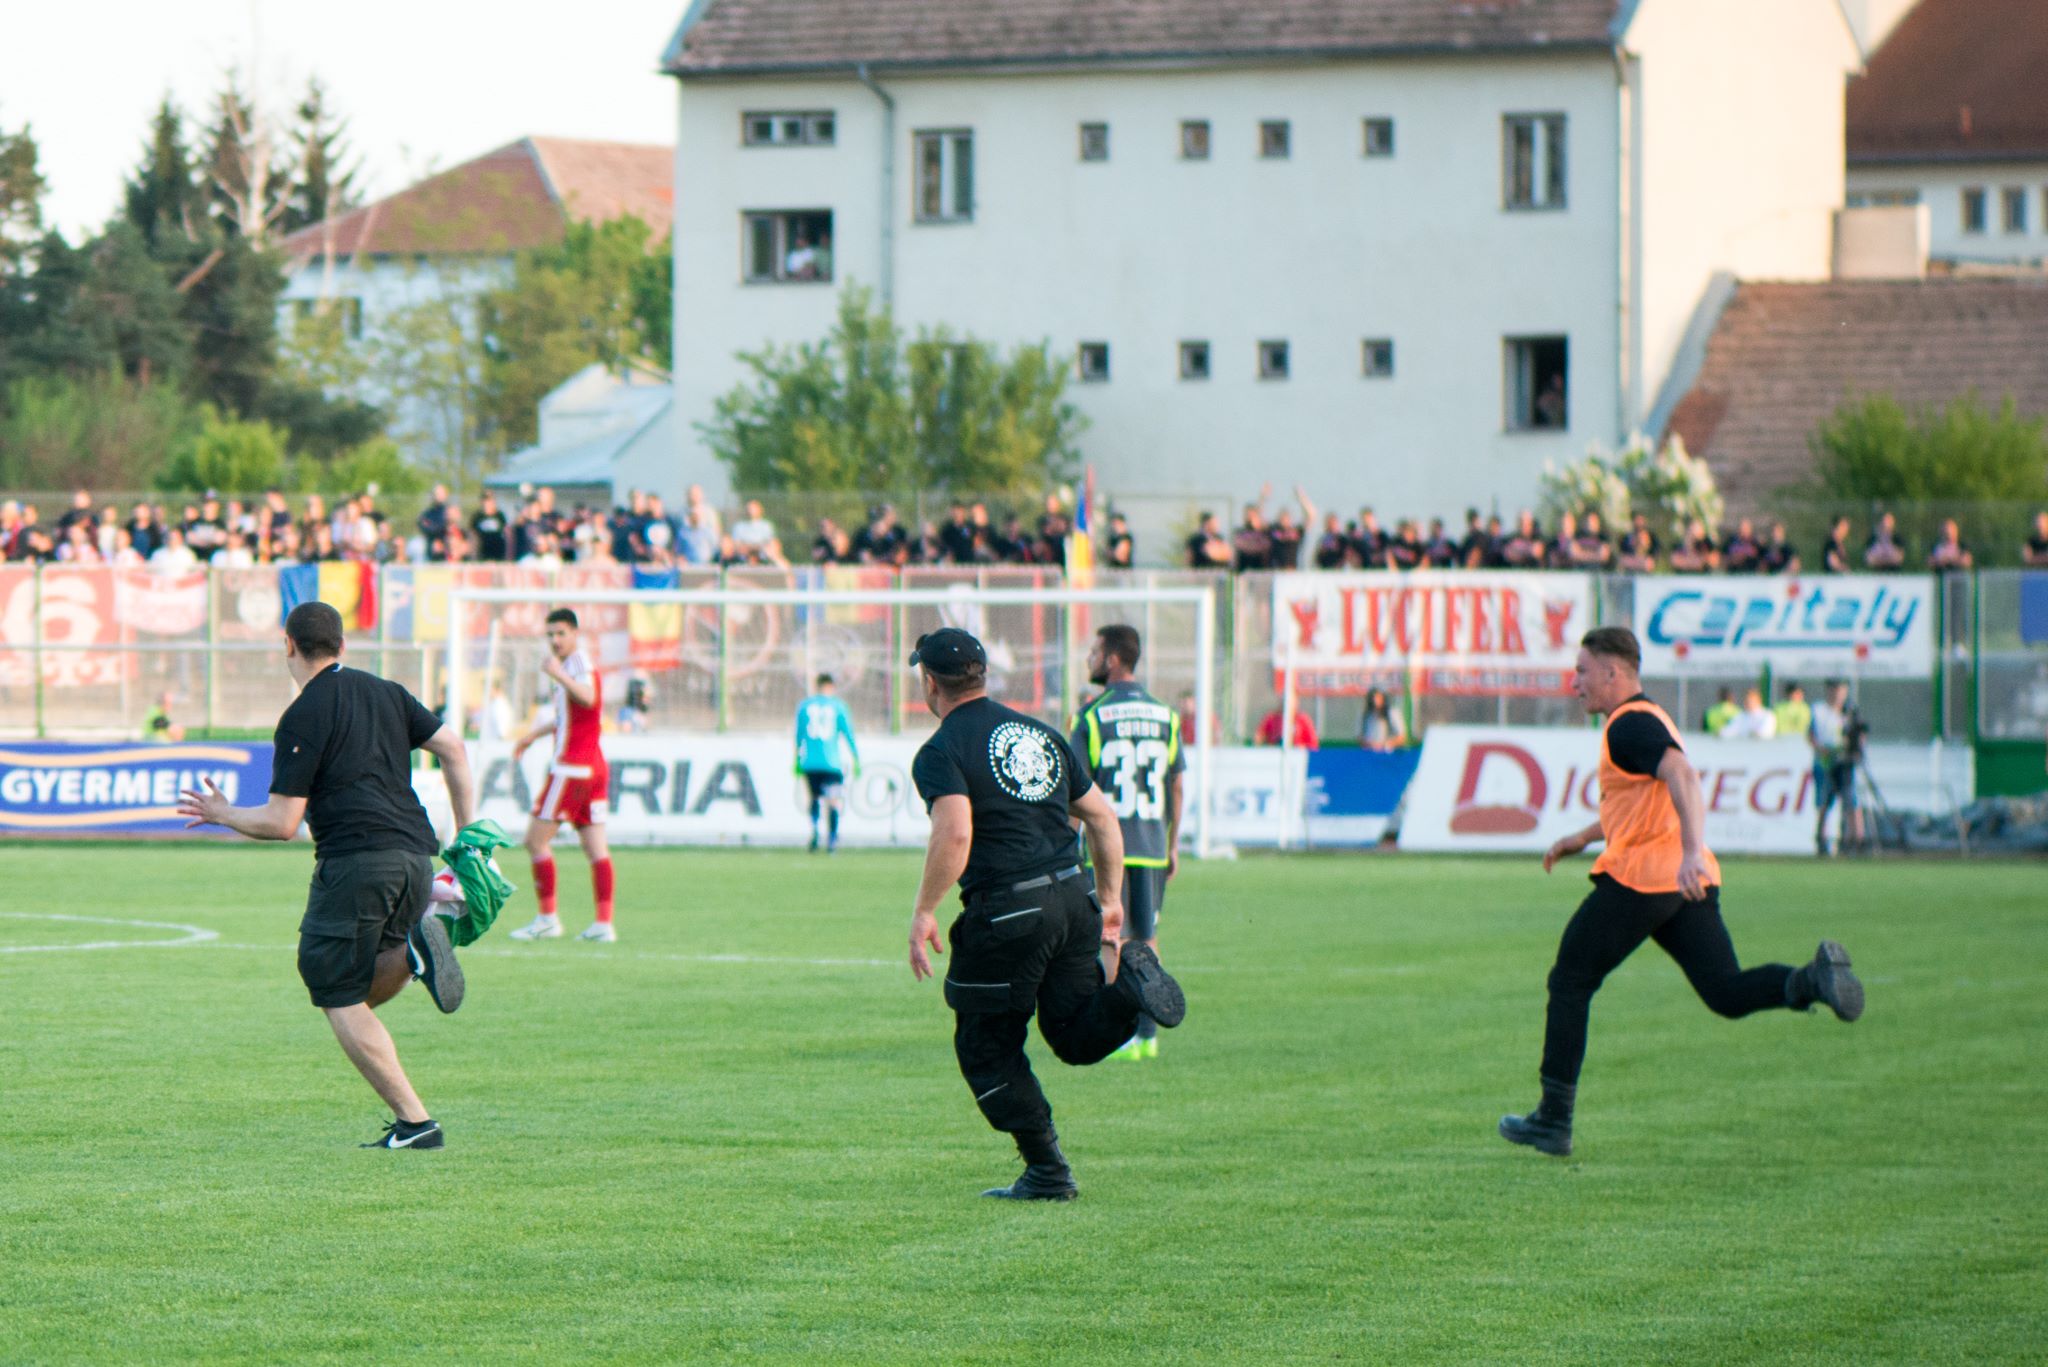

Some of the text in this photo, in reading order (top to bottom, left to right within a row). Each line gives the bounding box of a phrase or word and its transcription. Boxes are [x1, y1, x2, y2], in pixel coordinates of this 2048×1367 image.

[1339, 586, 1527, 656] LUCIFER
[1647, 585, 1921, 646] Capitaly
[478, 759, 763, 817] ARIA
[1101, 739, 1169, 820] 33
